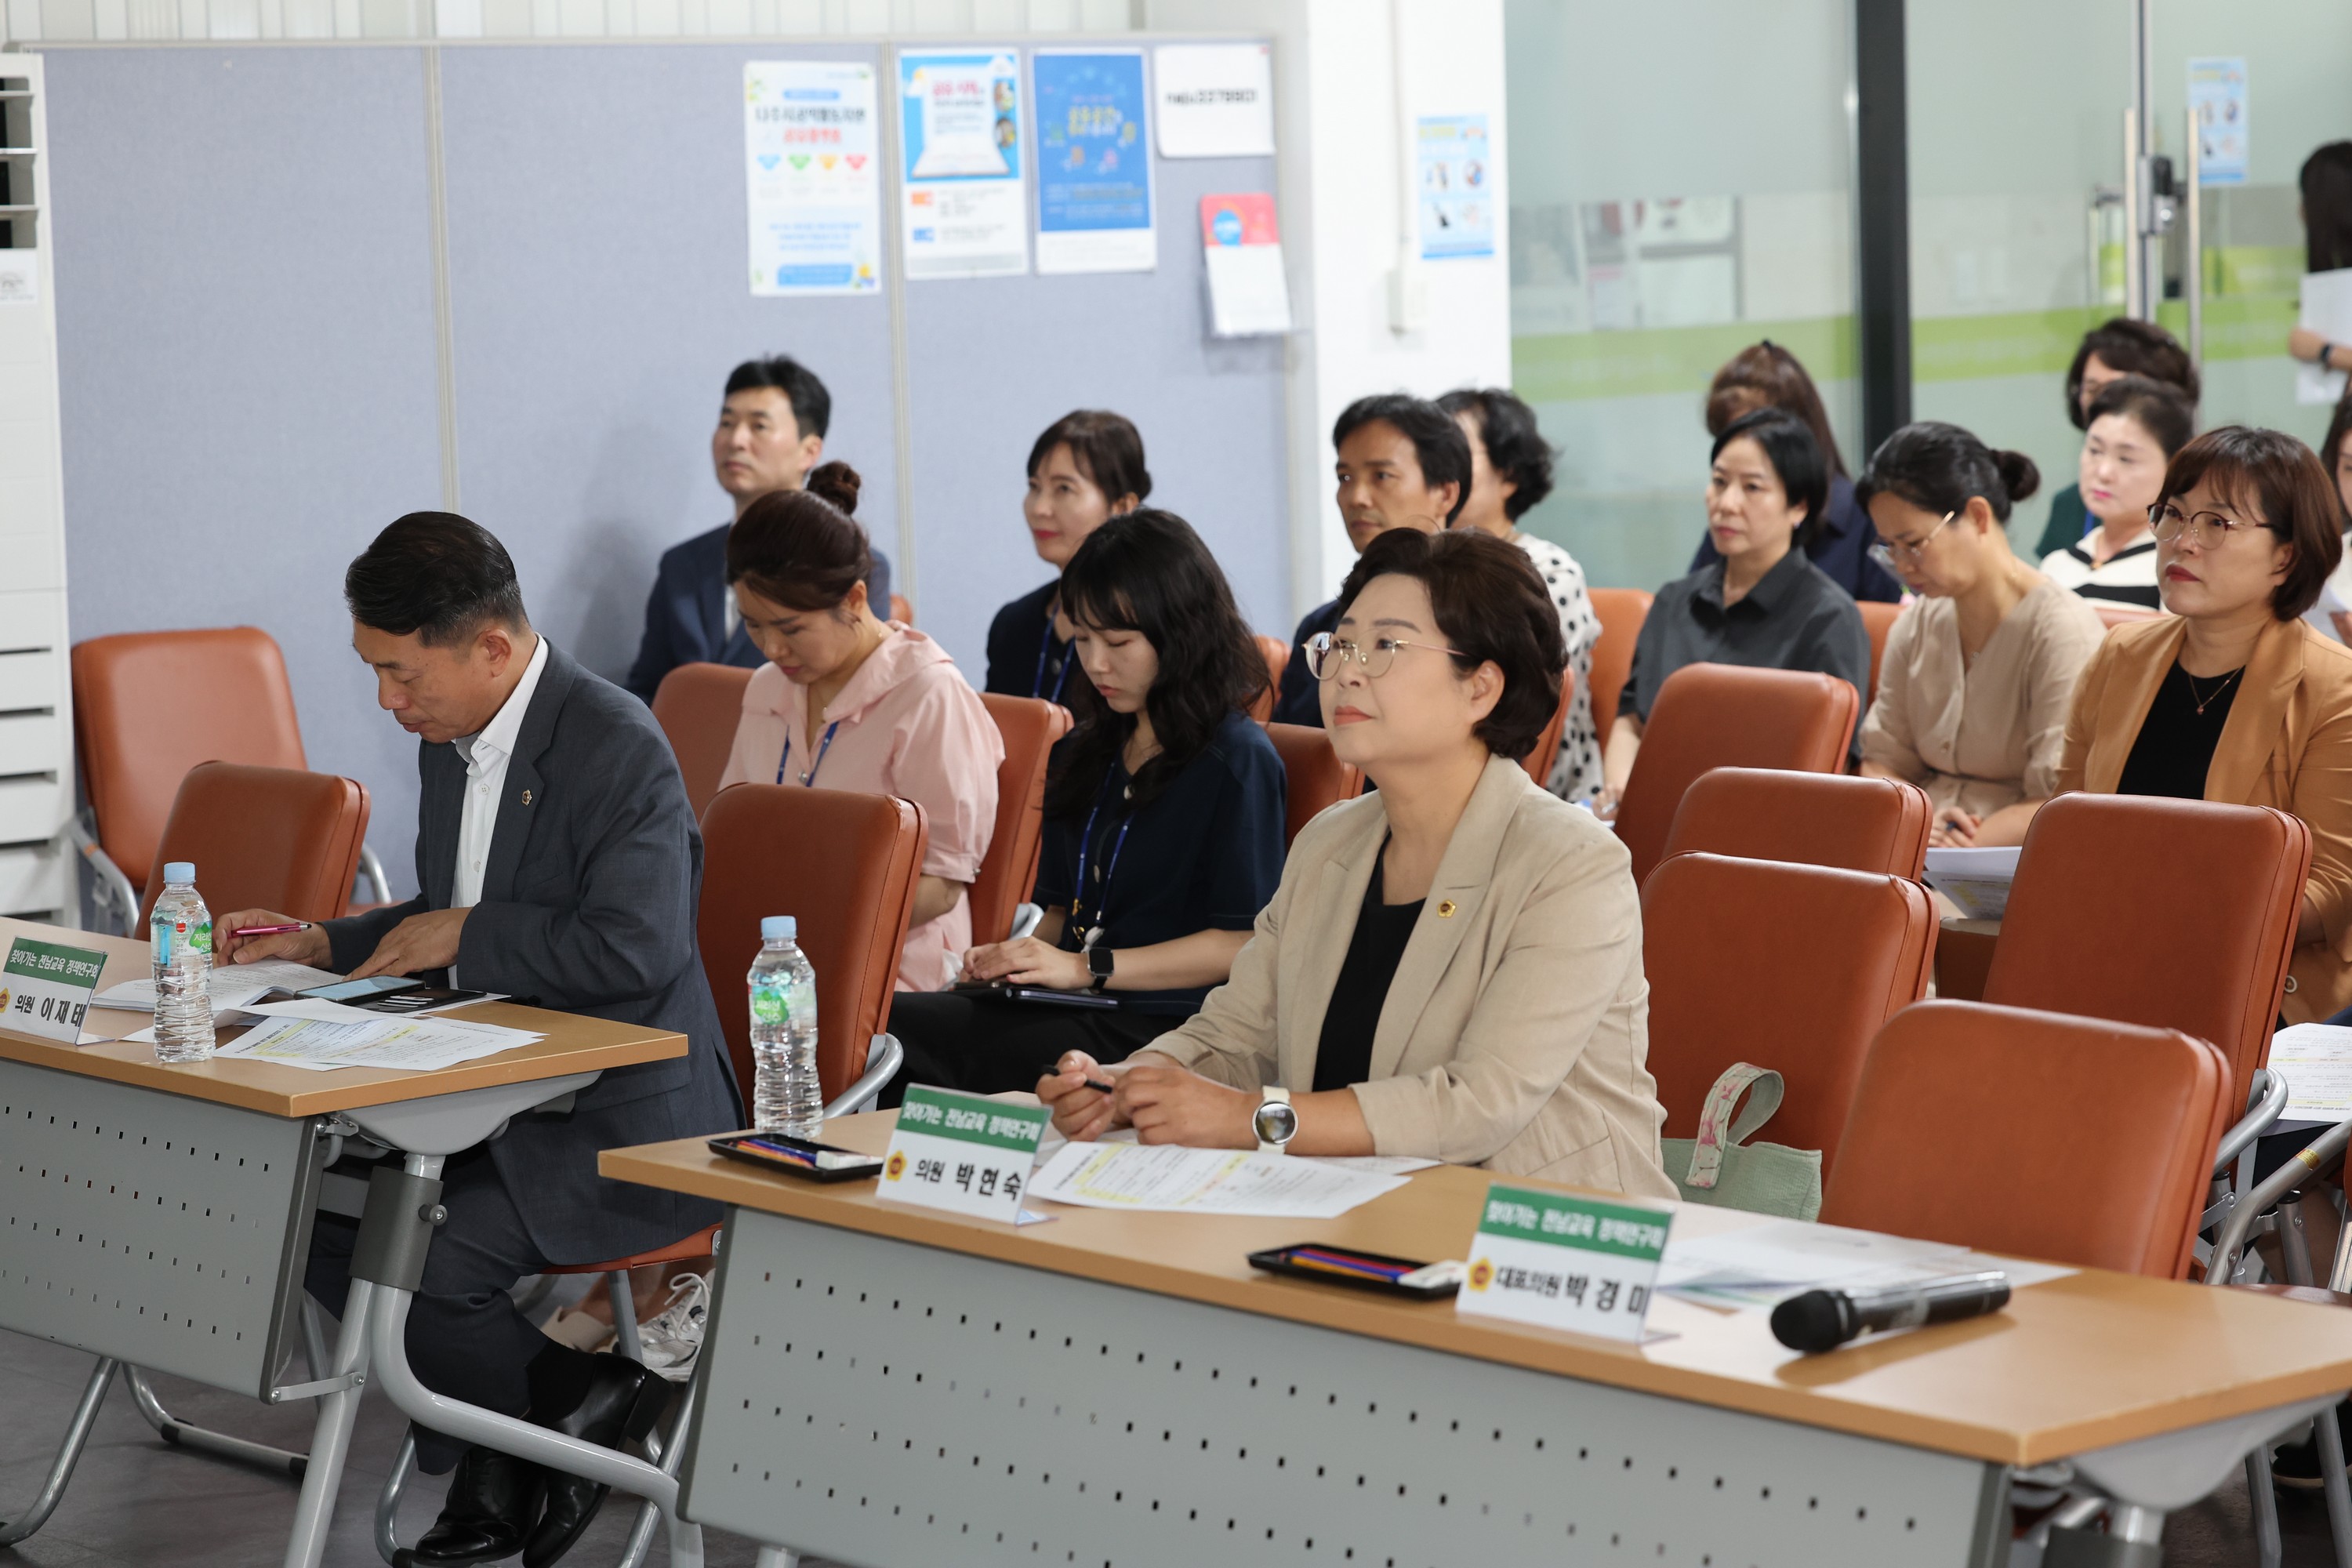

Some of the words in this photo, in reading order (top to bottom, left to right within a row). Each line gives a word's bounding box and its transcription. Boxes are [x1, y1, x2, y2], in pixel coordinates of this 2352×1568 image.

[10, 949, 38, 967] 찾아가는
[38, 954, 66, 973] 전남교육
[66, 960, 100, 978] 정책연구회
[15, 994, 36, 1014] 의원
[902, 1101, 943, 1125] 찾아가는
[945, 1108, 987, 1133] 전남교육
[989, 1115, 1042, 1142] 정책연구회
[915, 1159, 946, 1183] 의원
